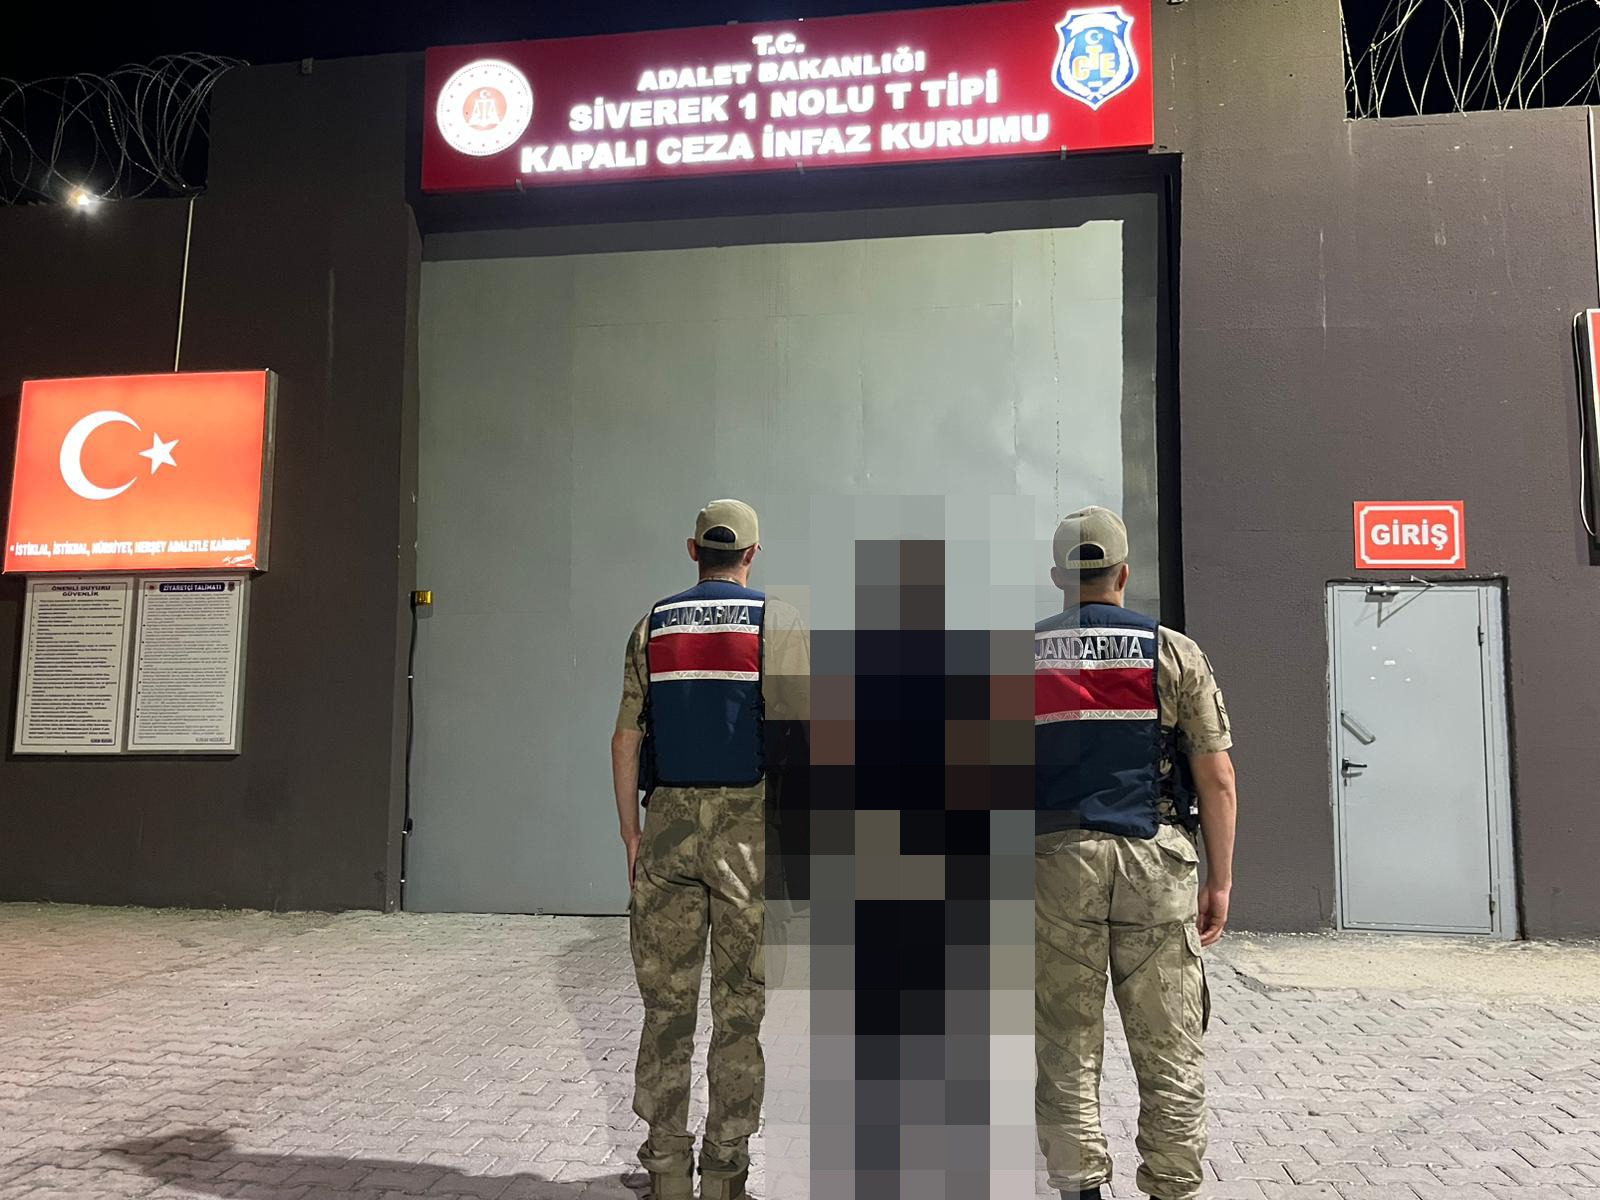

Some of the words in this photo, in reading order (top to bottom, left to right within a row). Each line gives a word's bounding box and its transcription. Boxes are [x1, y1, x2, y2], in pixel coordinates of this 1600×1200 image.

[751, 33, 806, 56] T.C.
[636, 63, 752, 92] ADALET
[757, 46, 926, 83] BAKANLIĞI
[568, 96, 729, 132] SİVEREK
[737, 93, 757, 120] 1
[770, 85, 875, 118] NOLU
[884, 82, 912, 110] T
[920, 69, 998, 108] TİPİ
[520, 139, 648, 174] KAPALI
[656, 133, 755, 165] CEZA
[762, 124, 872, 159] İNFAZ
[880, 113, 1050, 151] KURUMU
[1370, 518, 1449, 551] GİRİŞ
[661, 605, 751, 629] JANDARMA
[1035, 636, 1144, 660] JANDARMA
